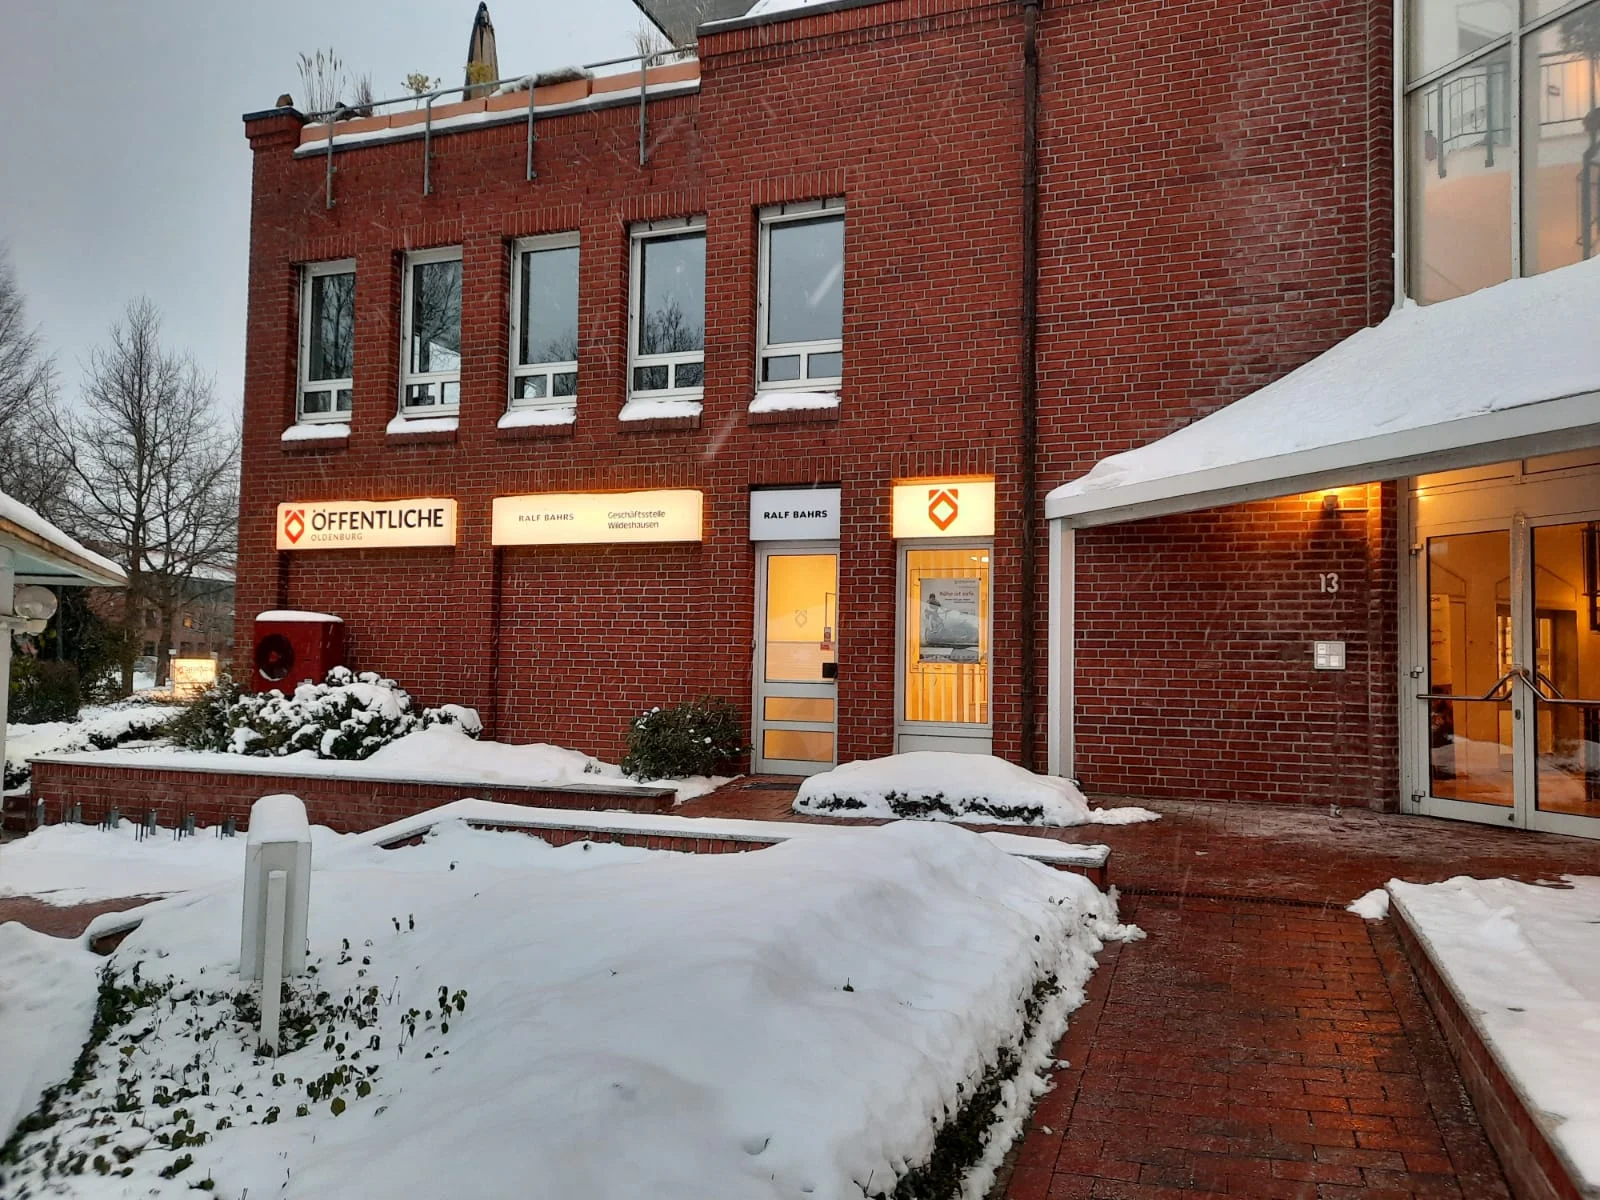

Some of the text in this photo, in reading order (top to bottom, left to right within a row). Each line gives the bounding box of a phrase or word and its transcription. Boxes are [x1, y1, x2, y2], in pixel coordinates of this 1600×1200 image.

[518, 513, 574, 522] RALF BAHRS
[607, 510, 666, 519] Geschäftsstelle
[763, 510, 828, 519] RALF BAHRS
[311, 508, 444, 531] ÖFFENTLICHE
[607, 521, 659, 529] Wildeshausen
[310, 533, 363, 542] OLDENBURG
[1319, 572, 1339, 593] 13
